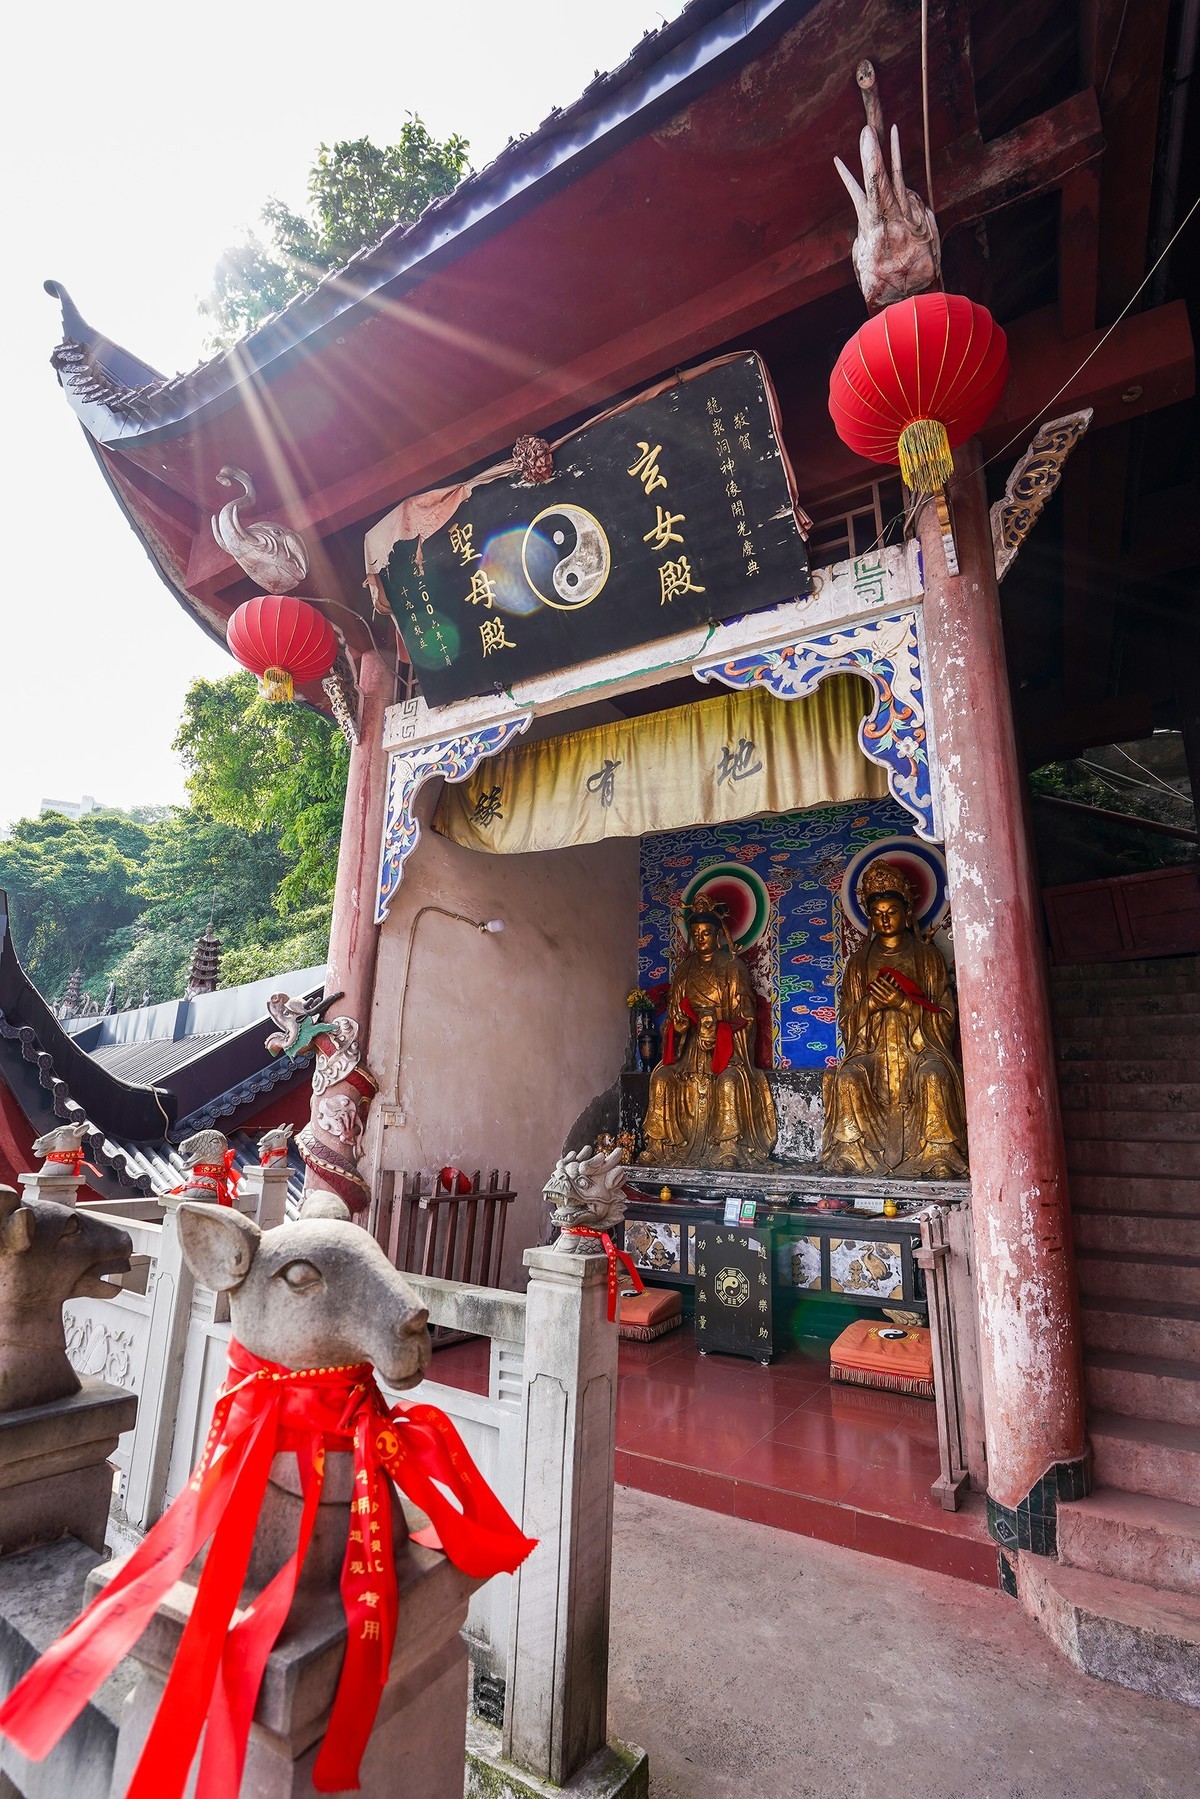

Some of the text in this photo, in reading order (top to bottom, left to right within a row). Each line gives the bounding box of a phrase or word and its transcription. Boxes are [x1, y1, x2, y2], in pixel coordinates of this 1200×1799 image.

[448, 523, 518, 658] 聖母殿
[627, 442, 706, 606] 玄女殿
